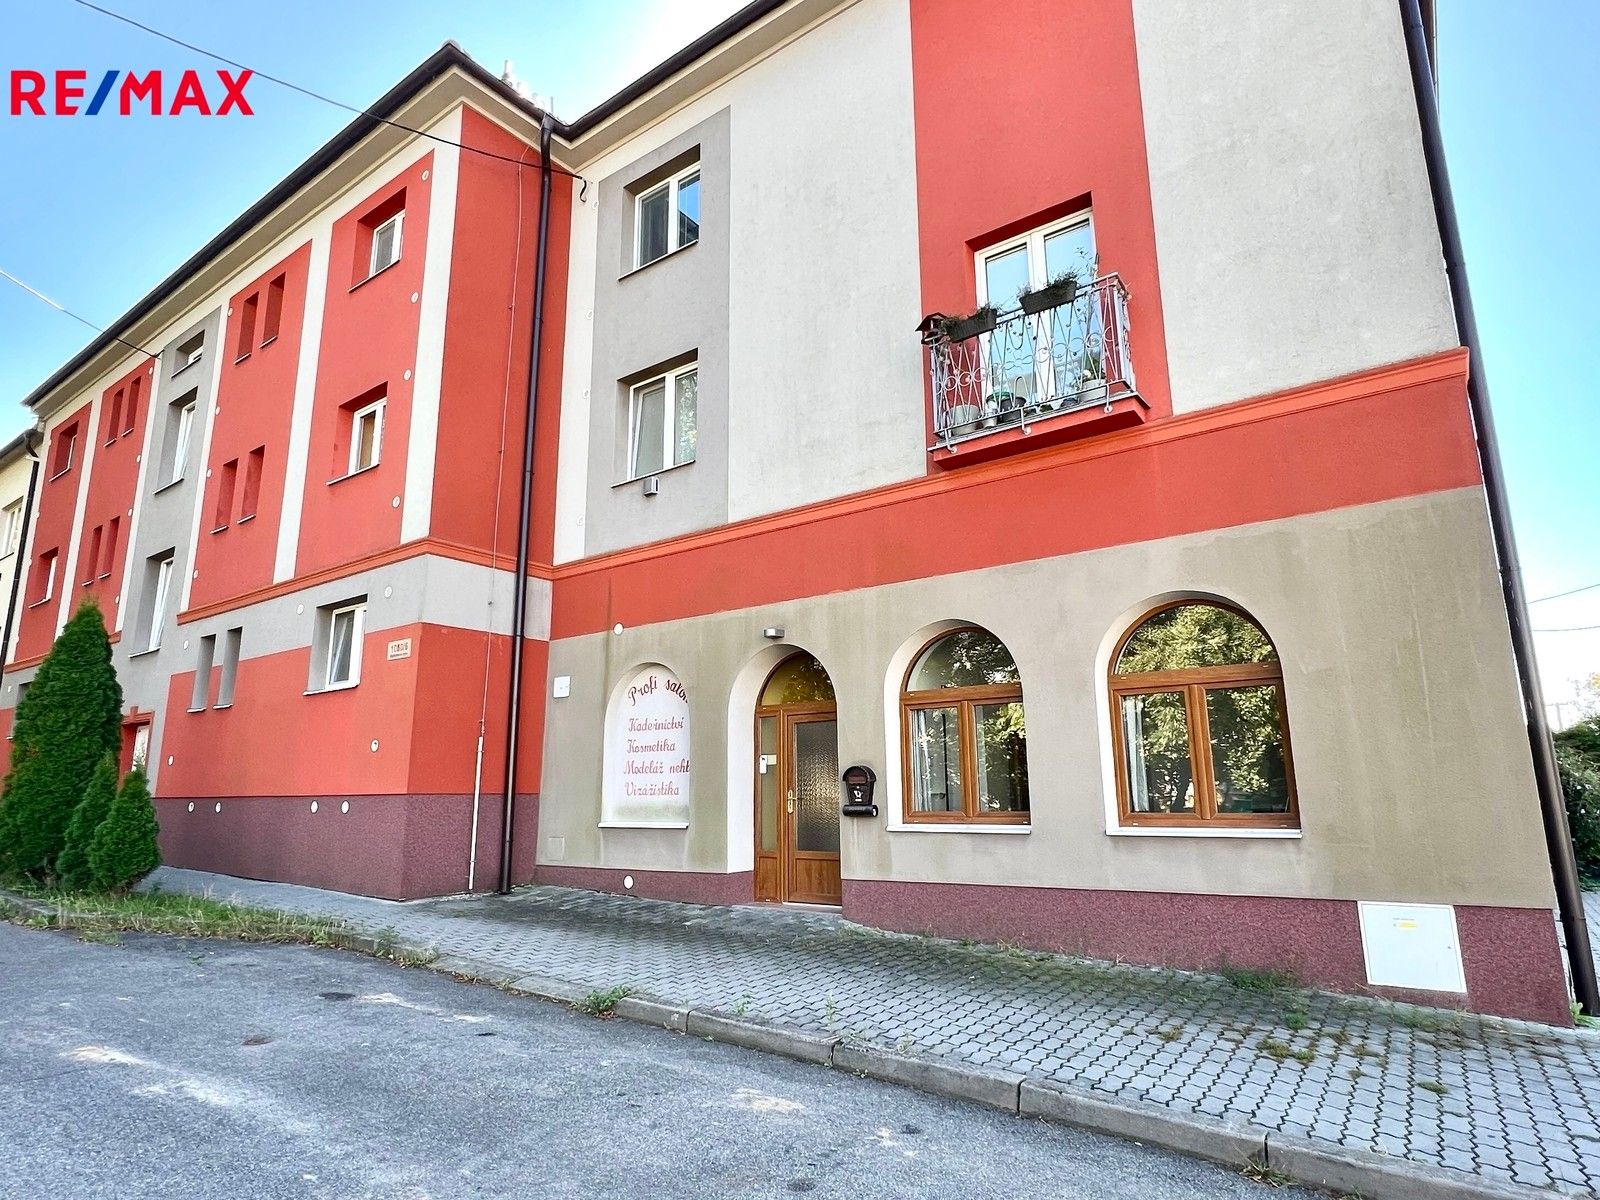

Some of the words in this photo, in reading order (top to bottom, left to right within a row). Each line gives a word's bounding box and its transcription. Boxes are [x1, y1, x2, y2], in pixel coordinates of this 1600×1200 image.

[628, 676, 658, 706] Profi
[627, 739, 676, 754] Kosmetika
[624, 760, 664, 774] Modeláž
[669, 758, 690, 774] neht
[625, 781, 679, 796] Vizážistika
